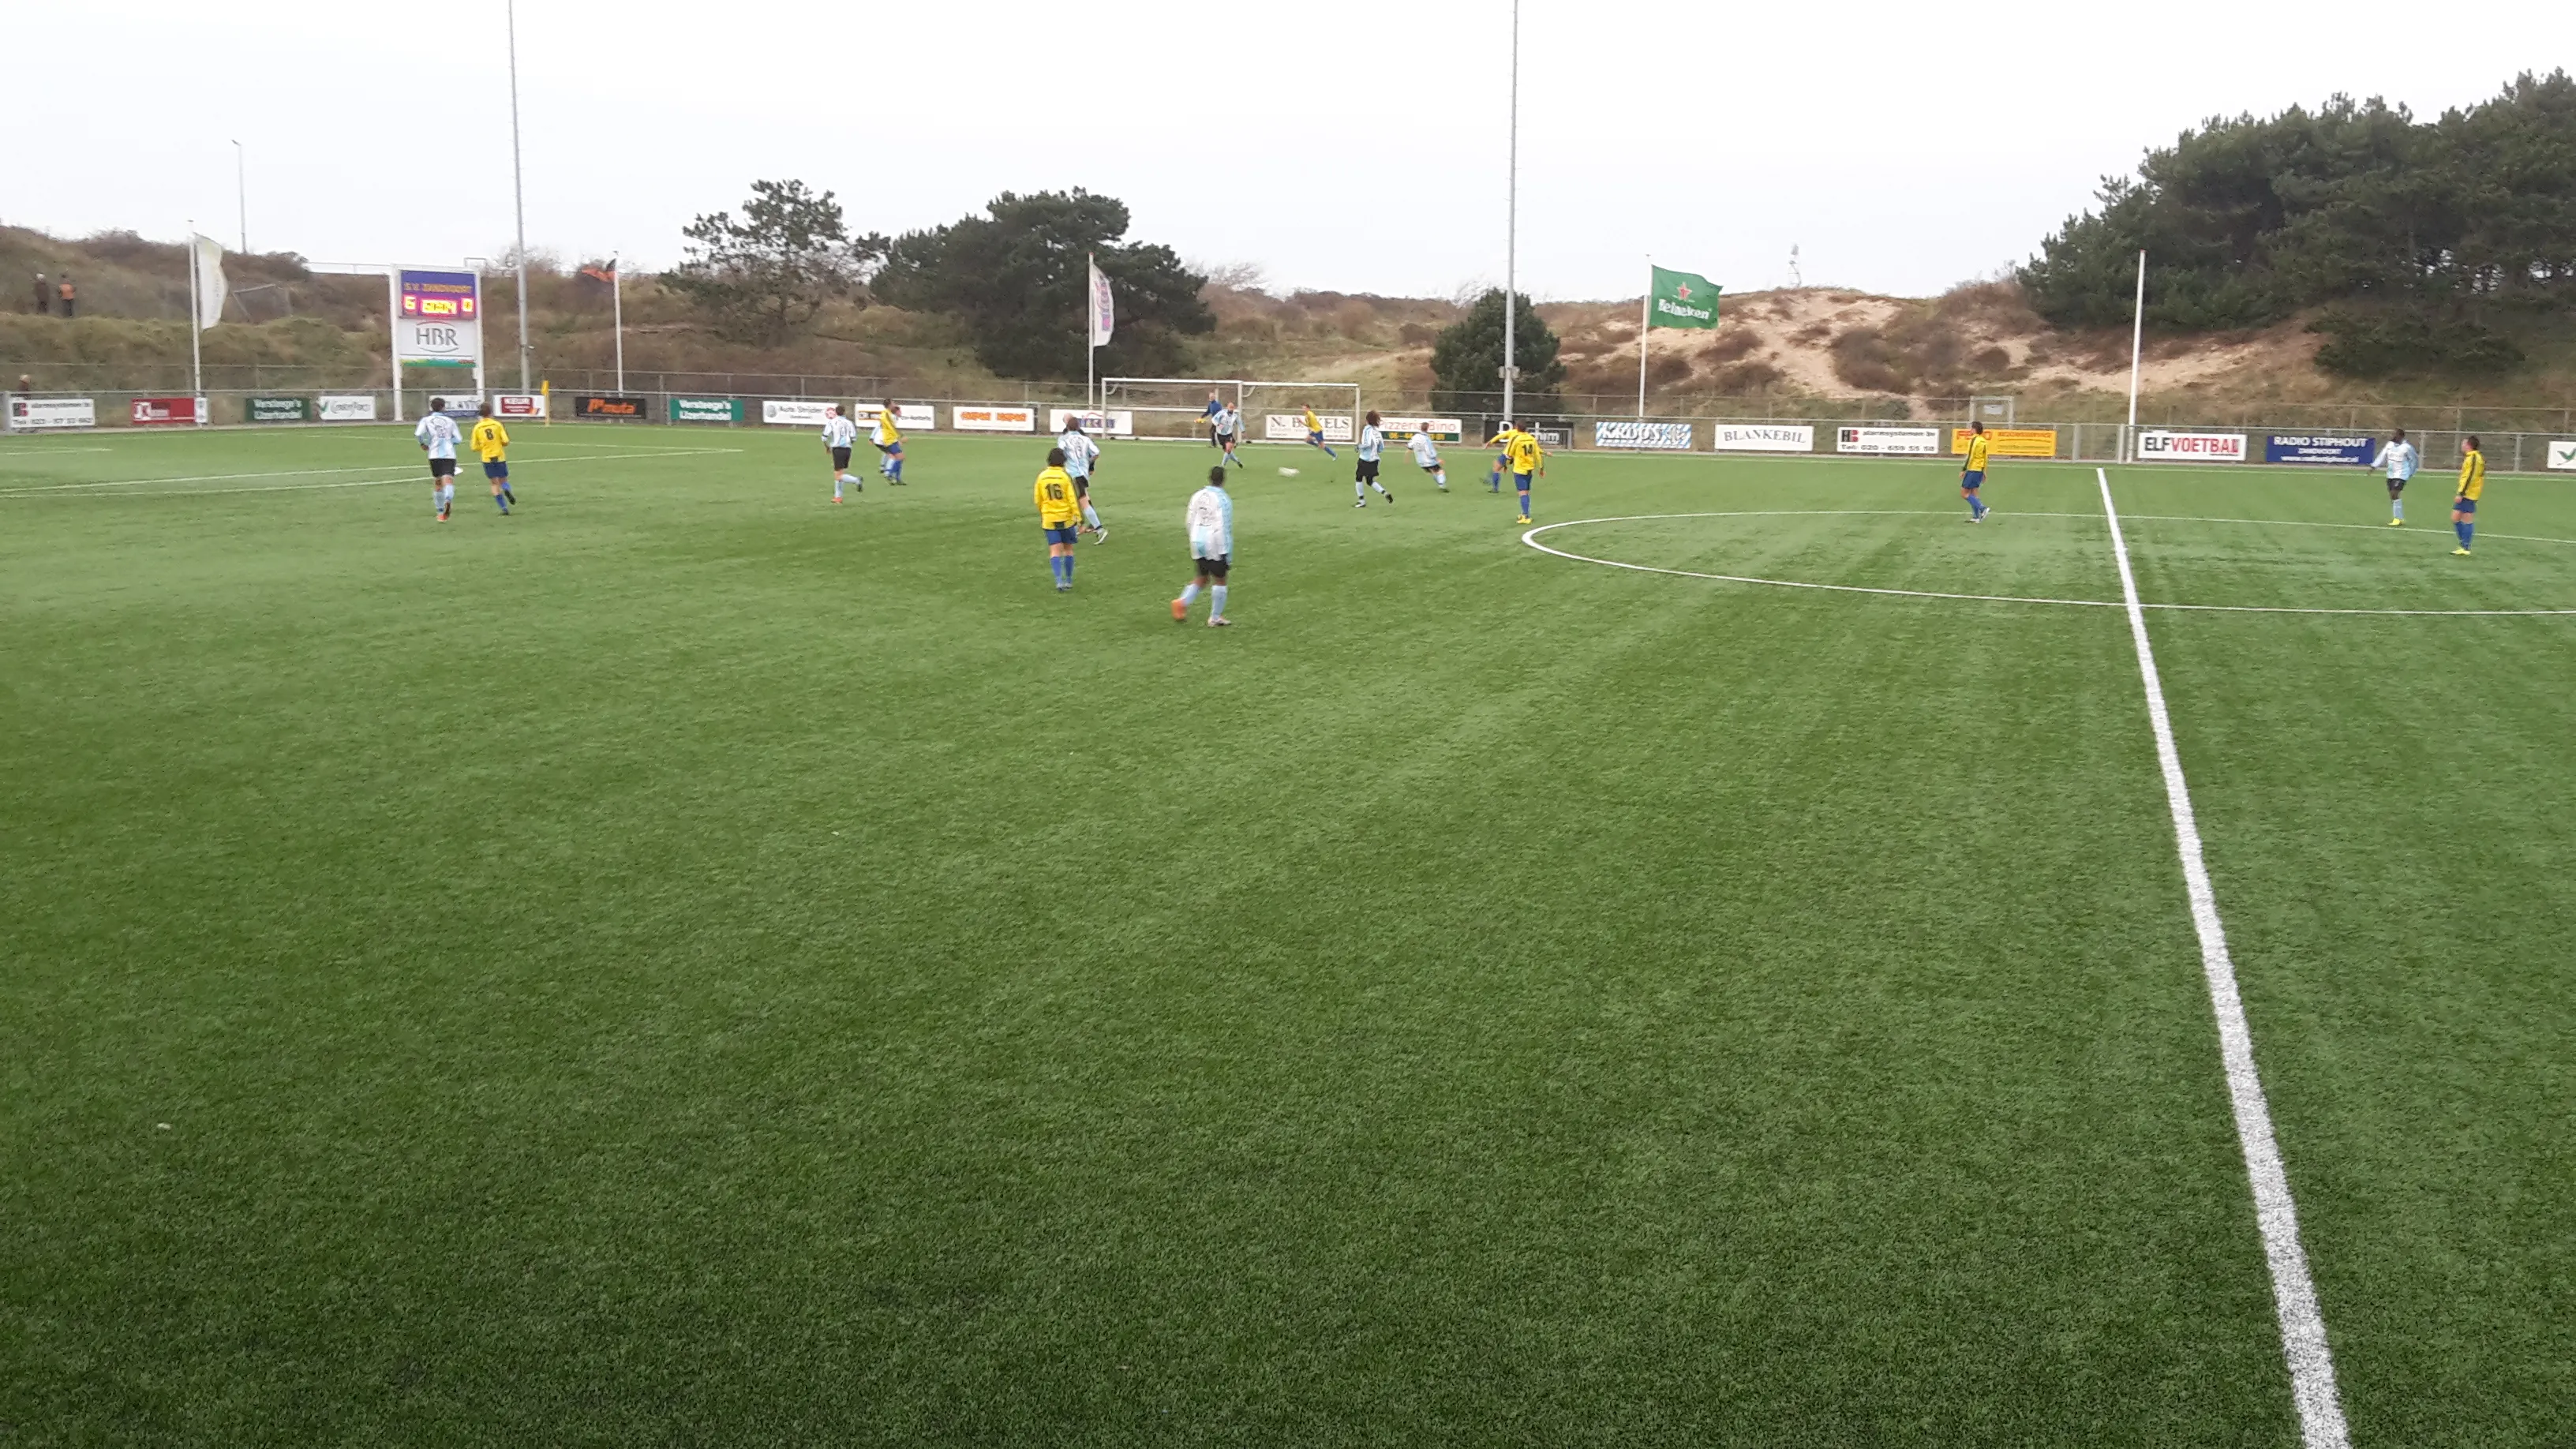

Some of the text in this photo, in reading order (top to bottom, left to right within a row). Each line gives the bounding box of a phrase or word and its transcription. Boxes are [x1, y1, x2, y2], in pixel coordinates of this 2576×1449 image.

[416, 328, 459, 346] HBR
[1429, 421, 1456, 432] Bino
[485, 429, 493, 440] 8
[1724, 429, 1806, 443] BLANKEBIL
[2274, 436, 2367, 447] RADIO STIPHOUT
[1045, 483, 1063, 500] 16
